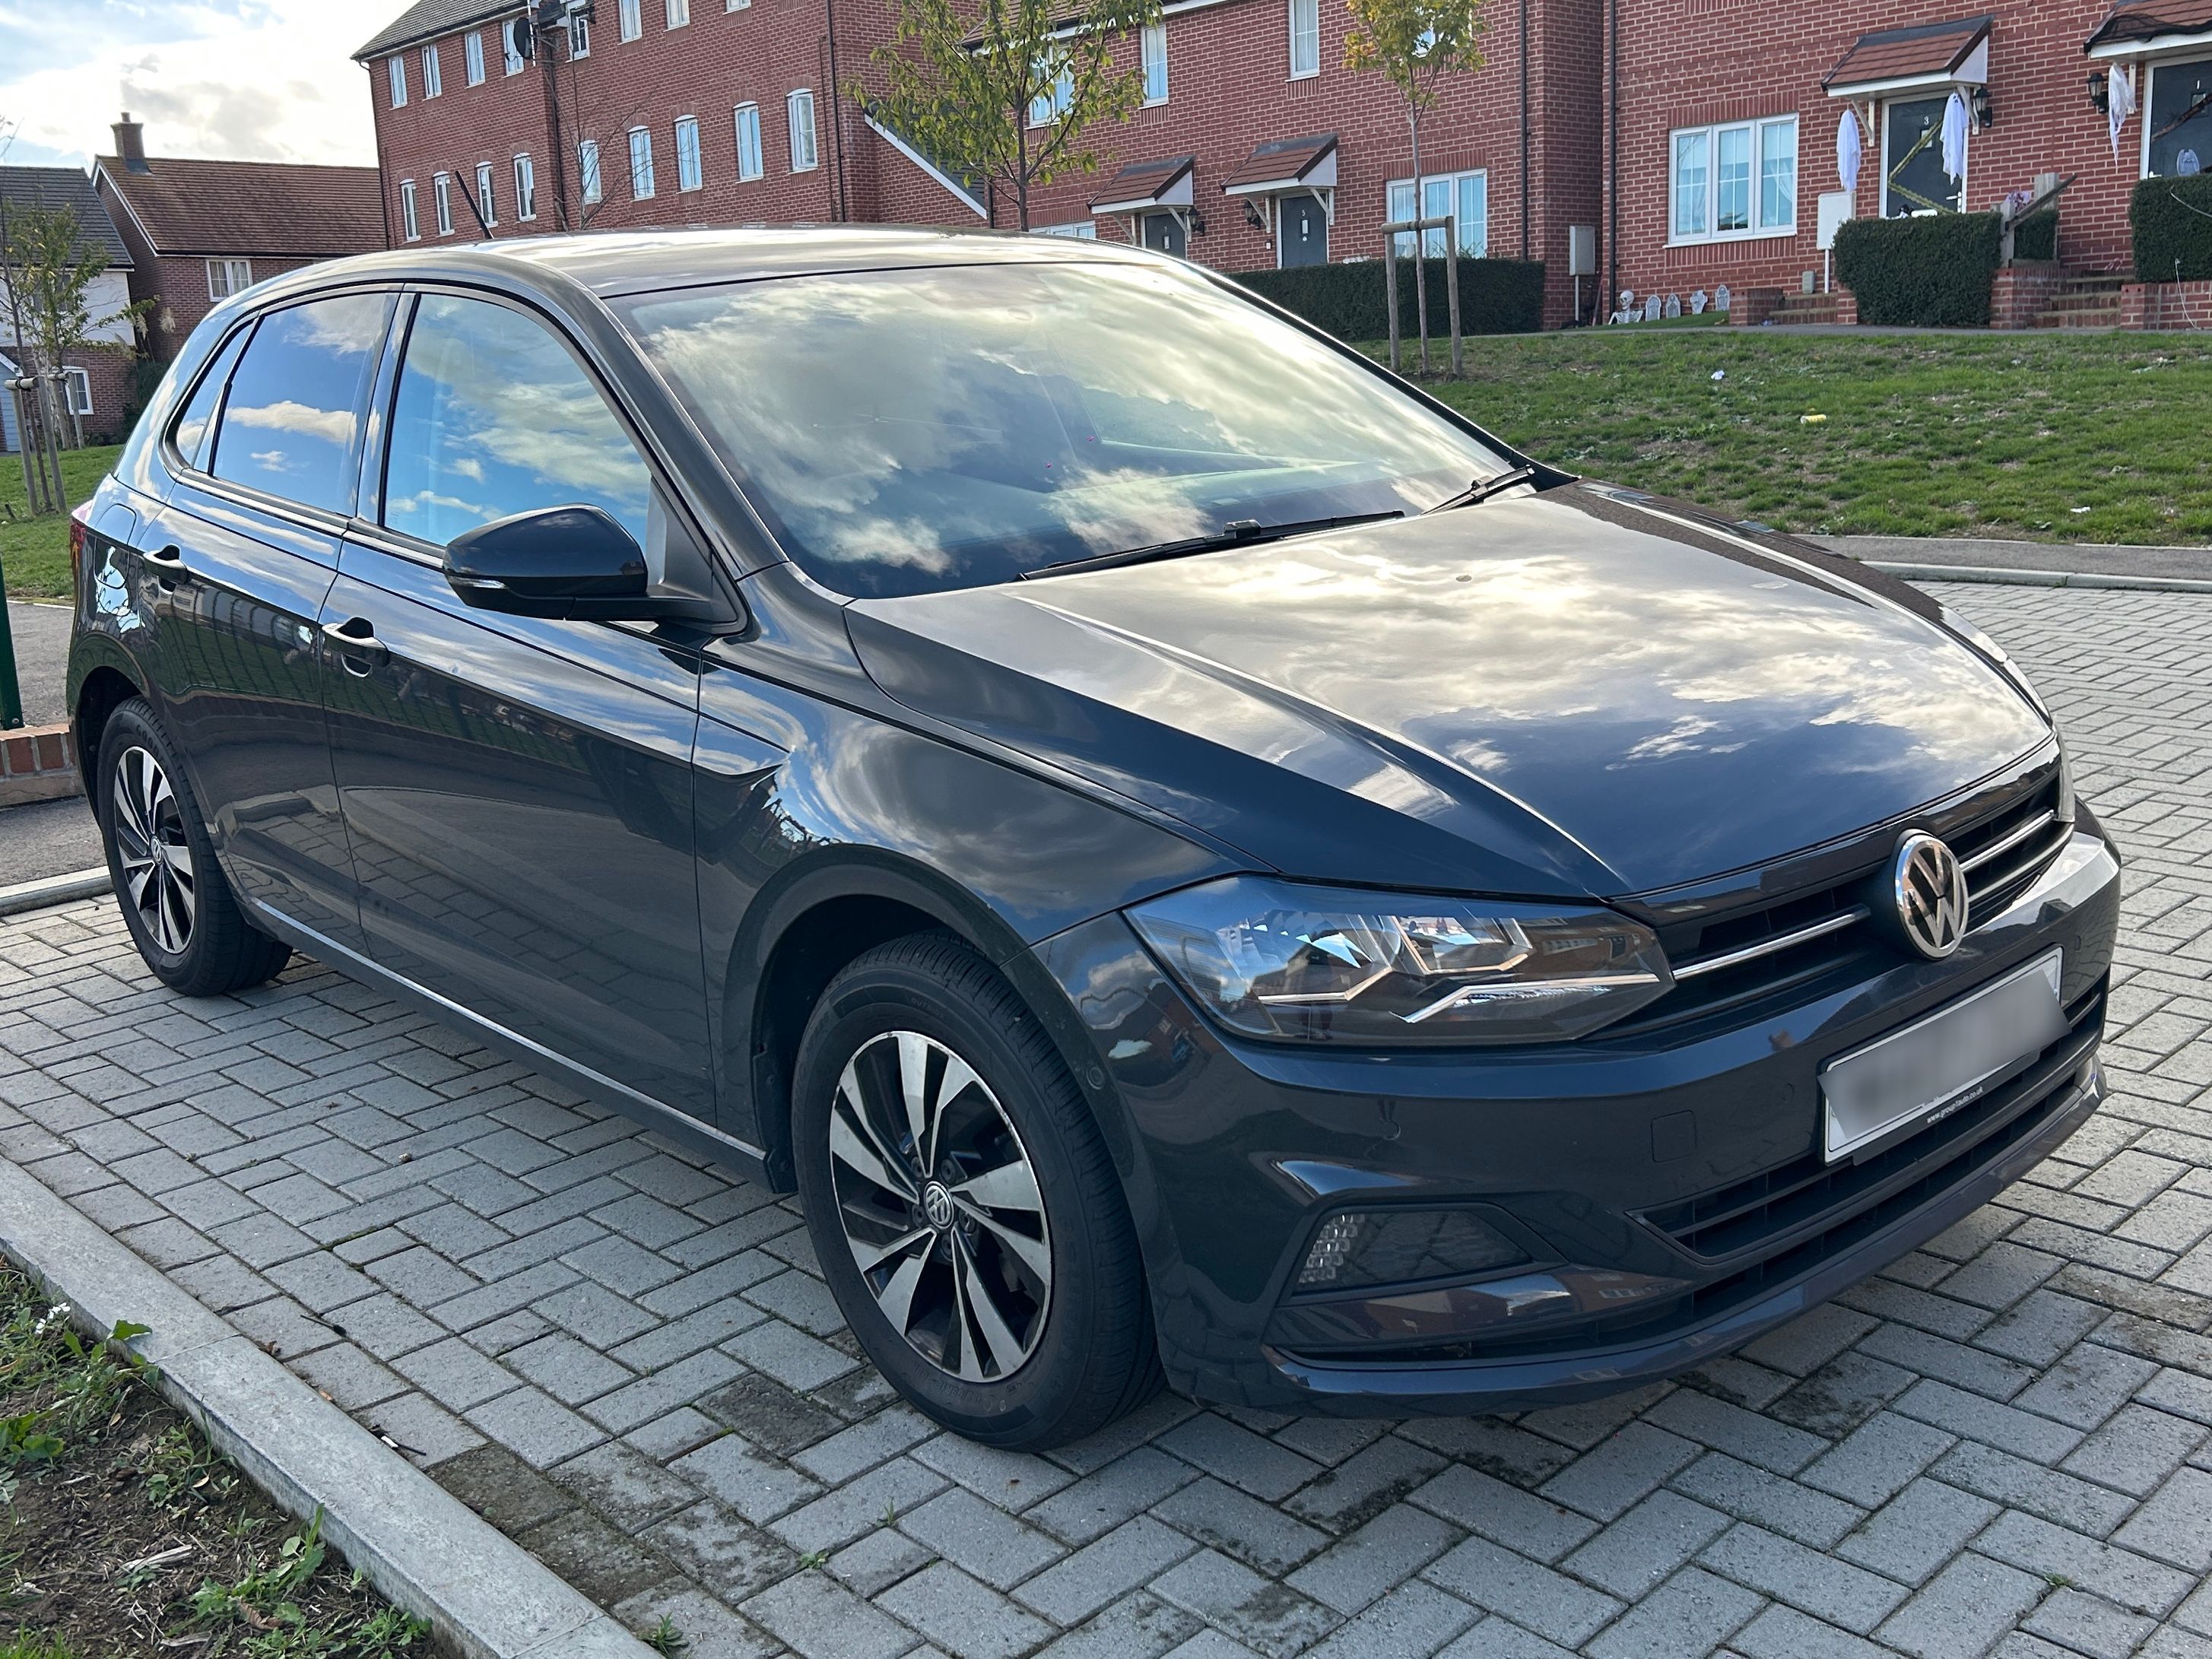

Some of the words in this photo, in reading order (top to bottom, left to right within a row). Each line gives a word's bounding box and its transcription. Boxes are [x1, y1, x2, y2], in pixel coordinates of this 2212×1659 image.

[1924, 116, 1929, 125] 3
[1301, 208, 1306, 217] 5
[1899, 839, 1965, 952] VW
